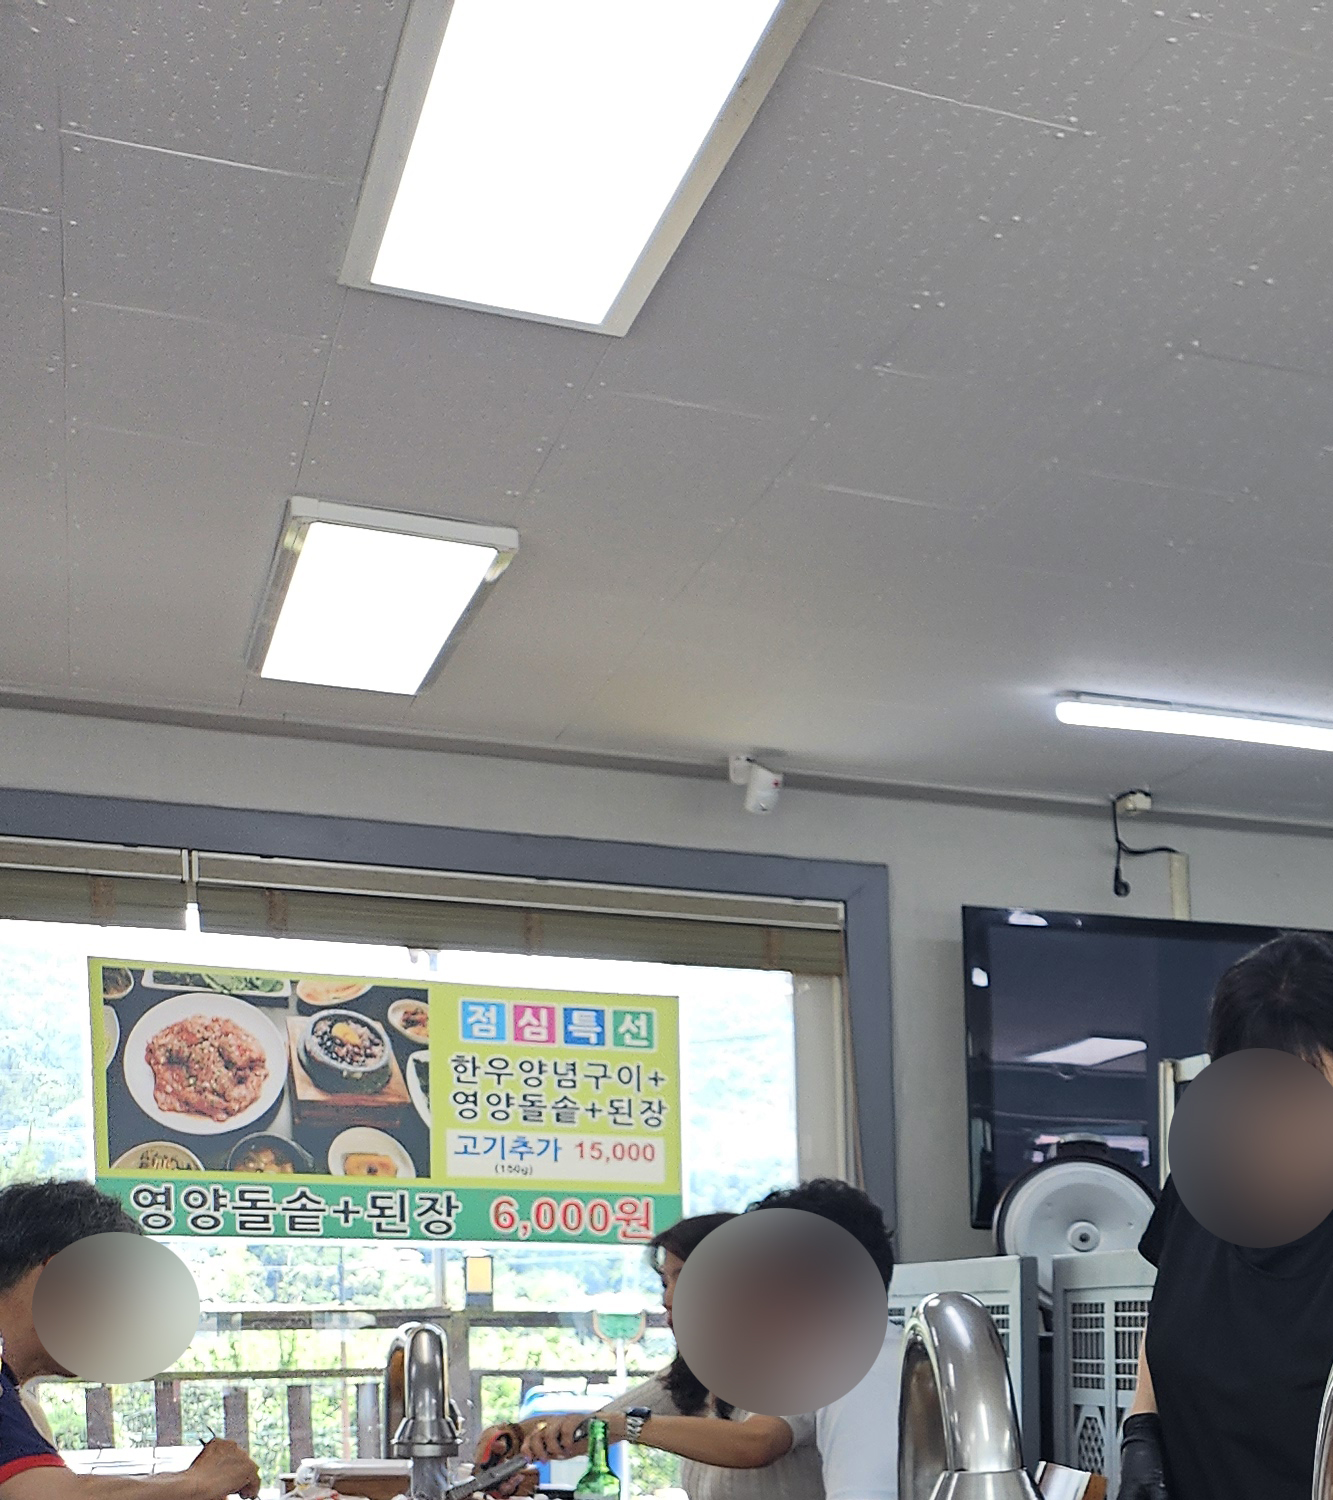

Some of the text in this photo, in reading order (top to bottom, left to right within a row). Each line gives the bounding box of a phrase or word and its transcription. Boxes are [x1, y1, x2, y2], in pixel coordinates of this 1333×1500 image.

[466, 1002, 652, 1048] 점심특선
[450, 1054, 666, 1092] 한우양념구이+
[452, 1090, 668, 1128] 영양돌솥+된장
[453, 1134, 656, 1163] 고기추가 15,000
[131, 1183, 656, 1240] 영양돌솥+된장 6,000원
